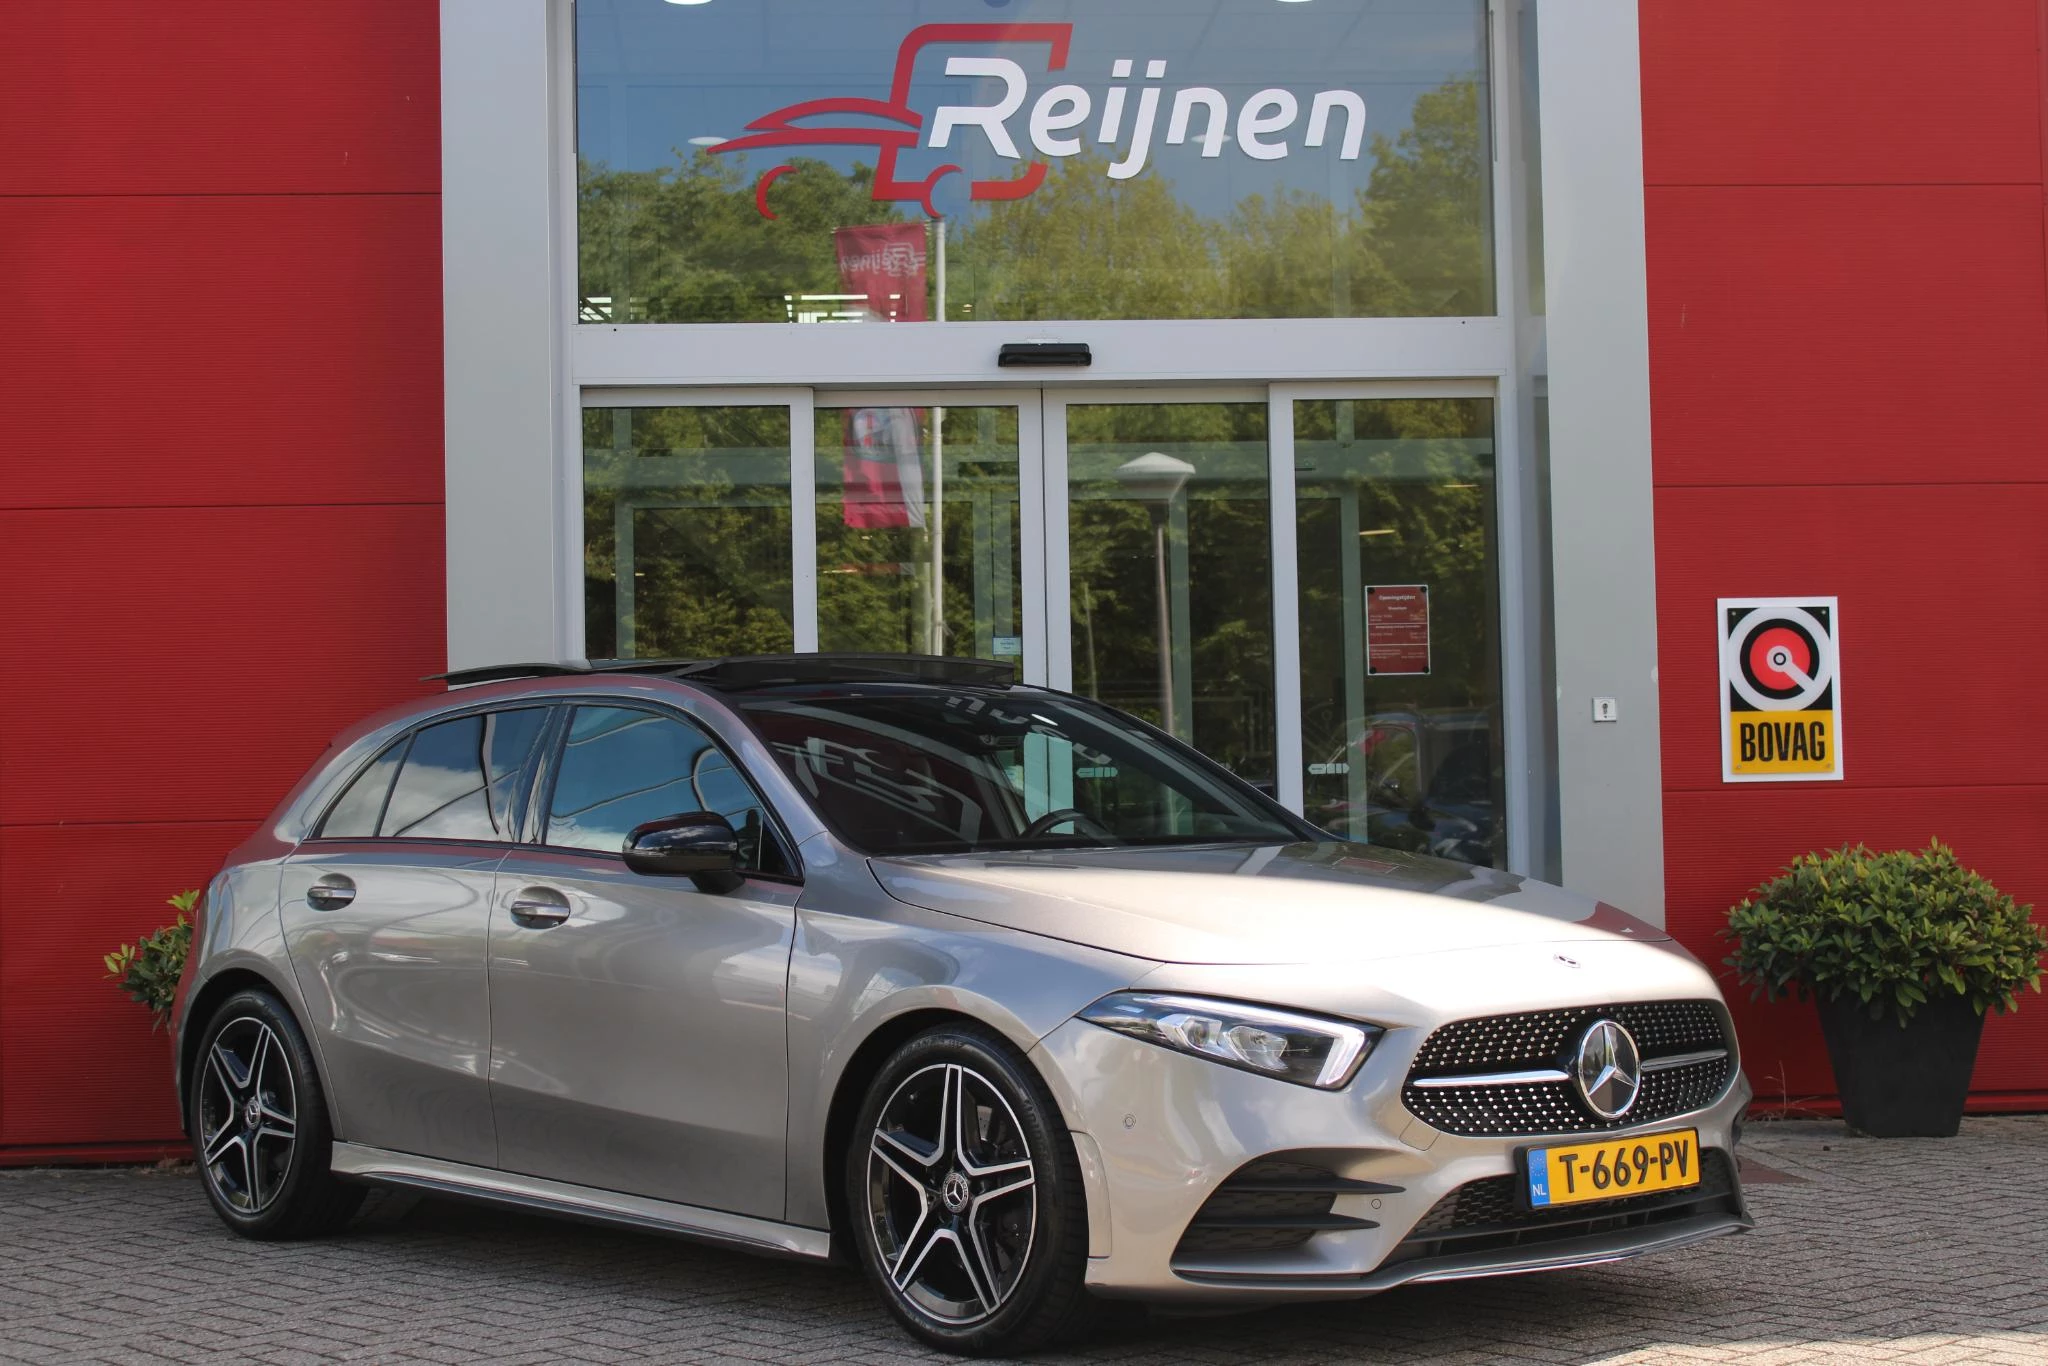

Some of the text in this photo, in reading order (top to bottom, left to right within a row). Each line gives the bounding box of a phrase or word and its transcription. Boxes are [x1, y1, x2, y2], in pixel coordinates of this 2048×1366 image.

[927, 57, 1367, 180] Reijnen
[1740, 721, 1826, 762] BOVAG
[1559, 1139, 1689, 1193] T-669-PV
[1533, 1184, 1547, 1197] NL
